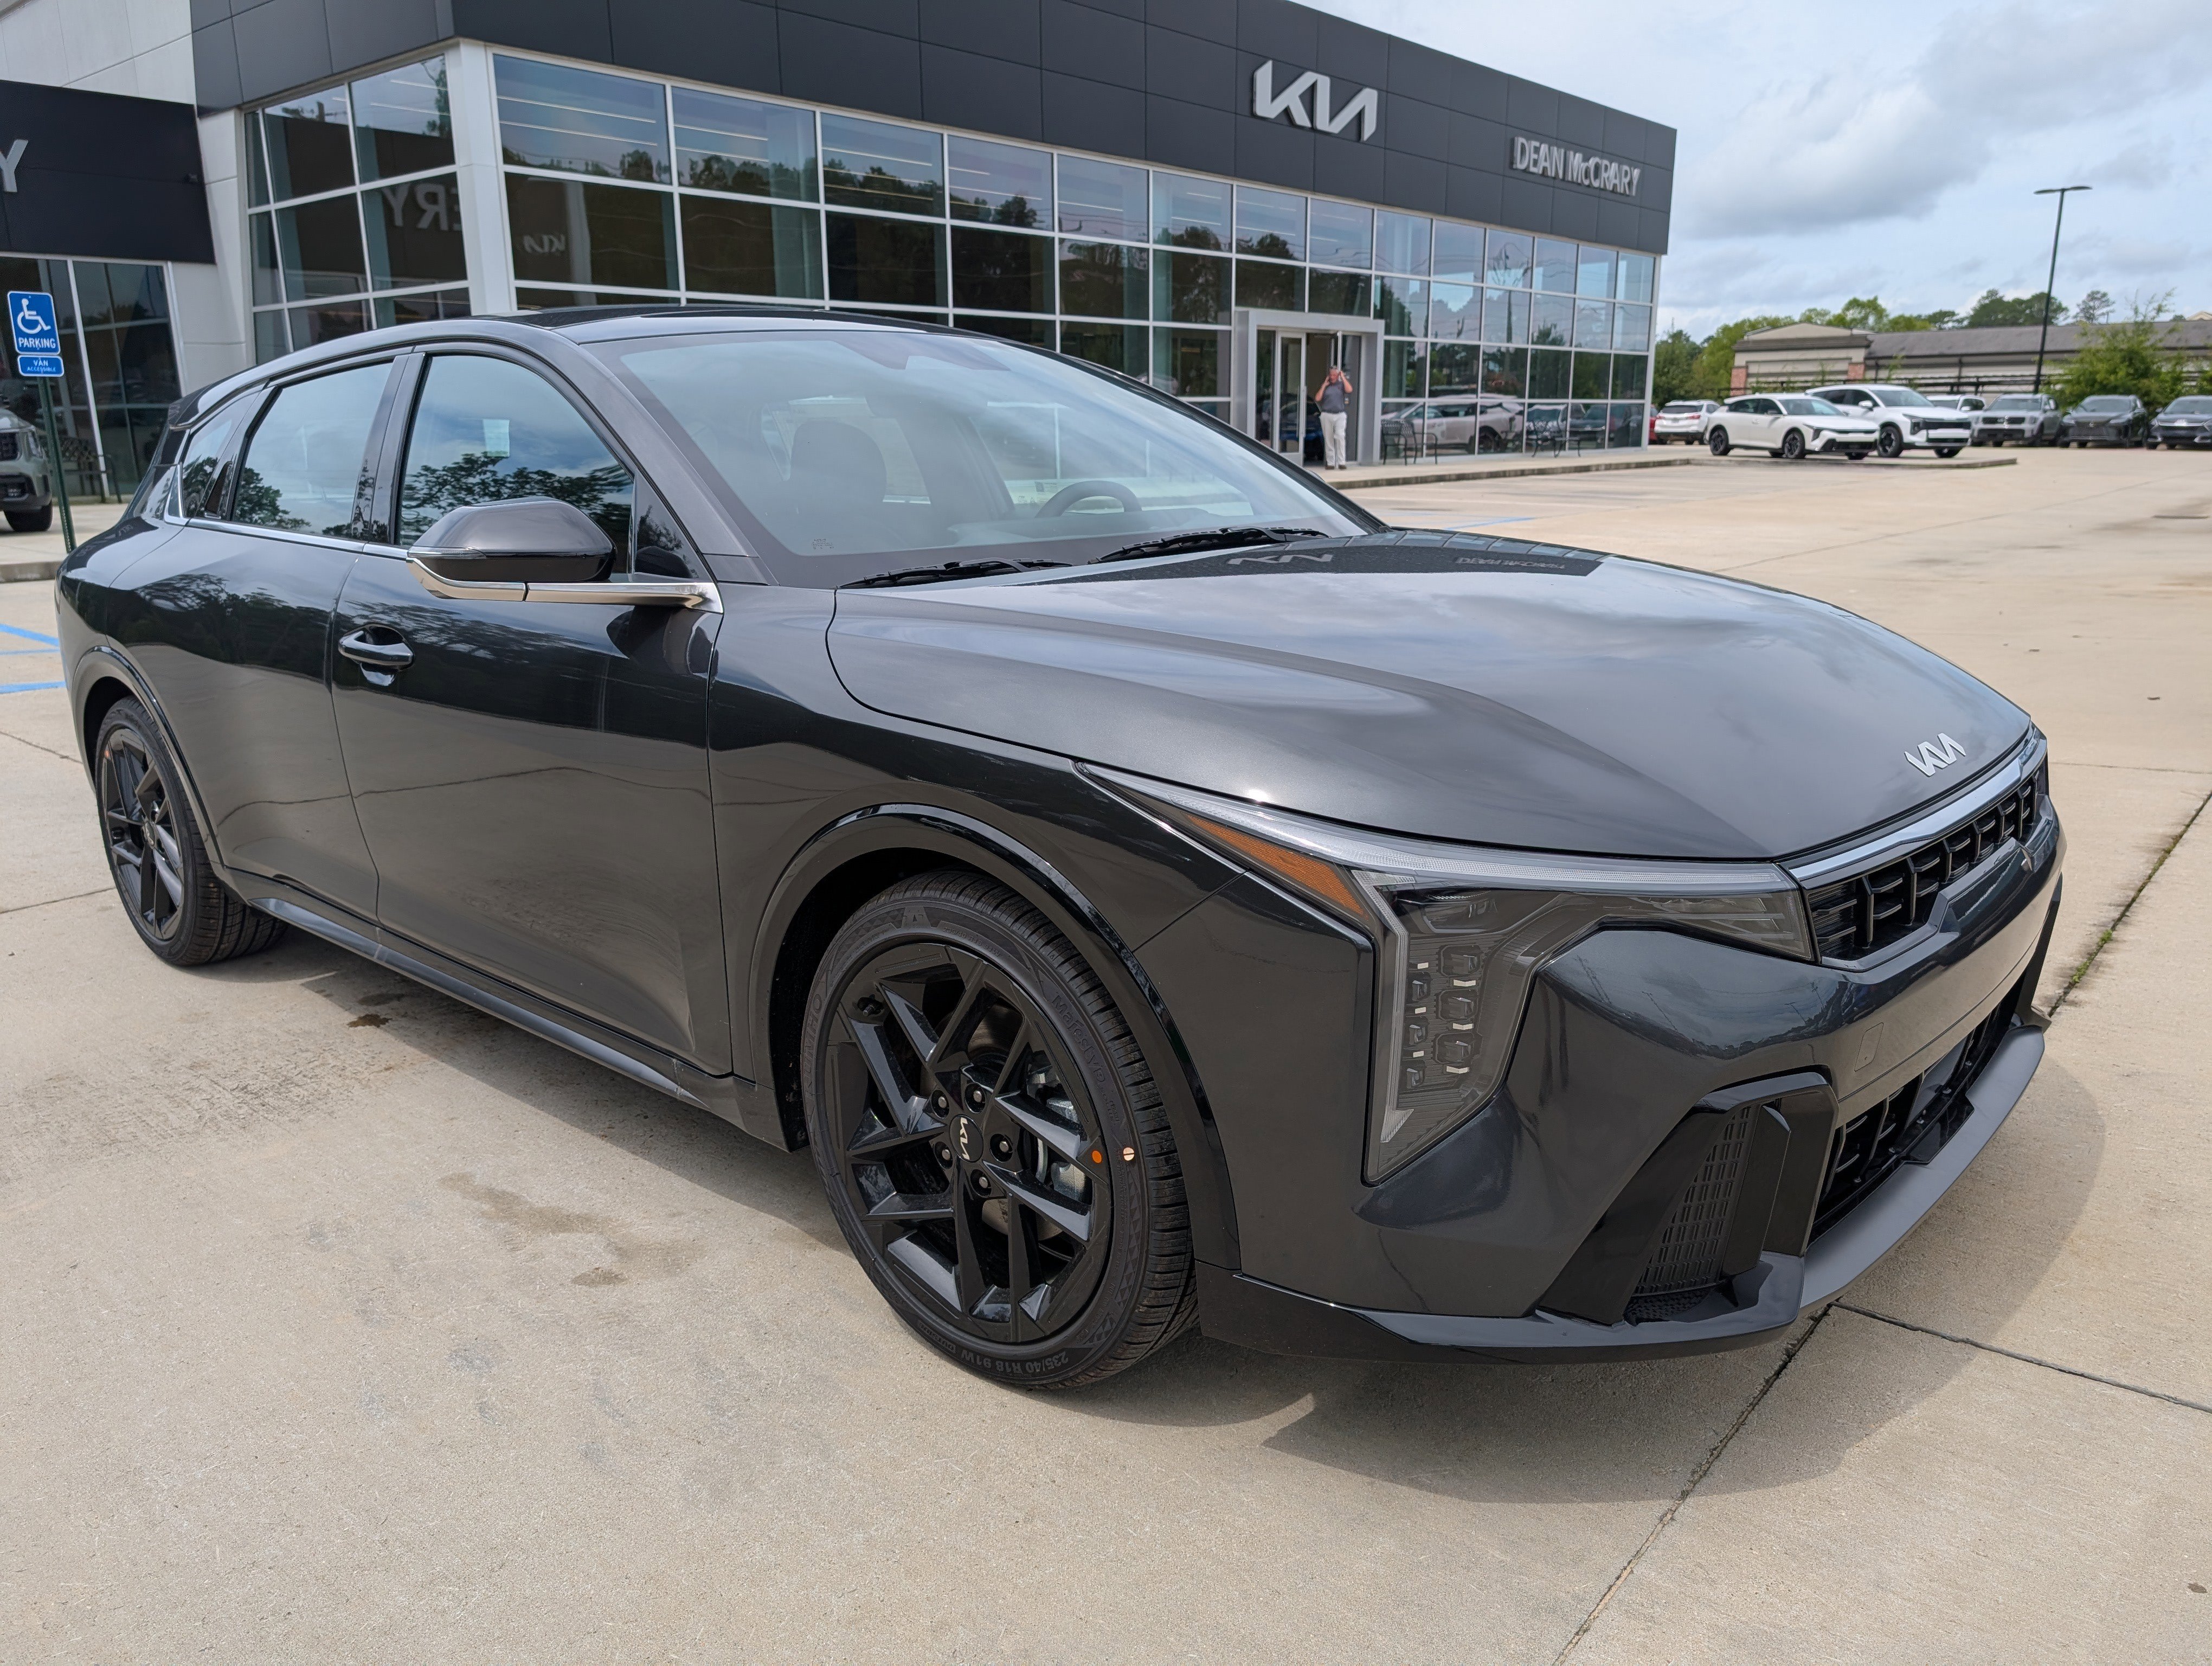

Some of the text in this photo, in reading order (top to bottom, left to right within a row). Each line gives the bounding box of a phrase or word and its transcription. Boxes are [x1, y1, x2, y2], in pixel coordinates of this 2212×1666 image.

[1253, 59, 1378, 142] KIA
[1513, 136, 1641, 196] DEAN McCRARY
[18, 337, 56, 348] PARKING
[1904, 733, 1966, 777] KIA
[804, 994, 822, 1099] KUMHO
[960, 1117, 970, 1160] KIA
[961, 1349, 1069, 1374] 235/40 R18 91W
